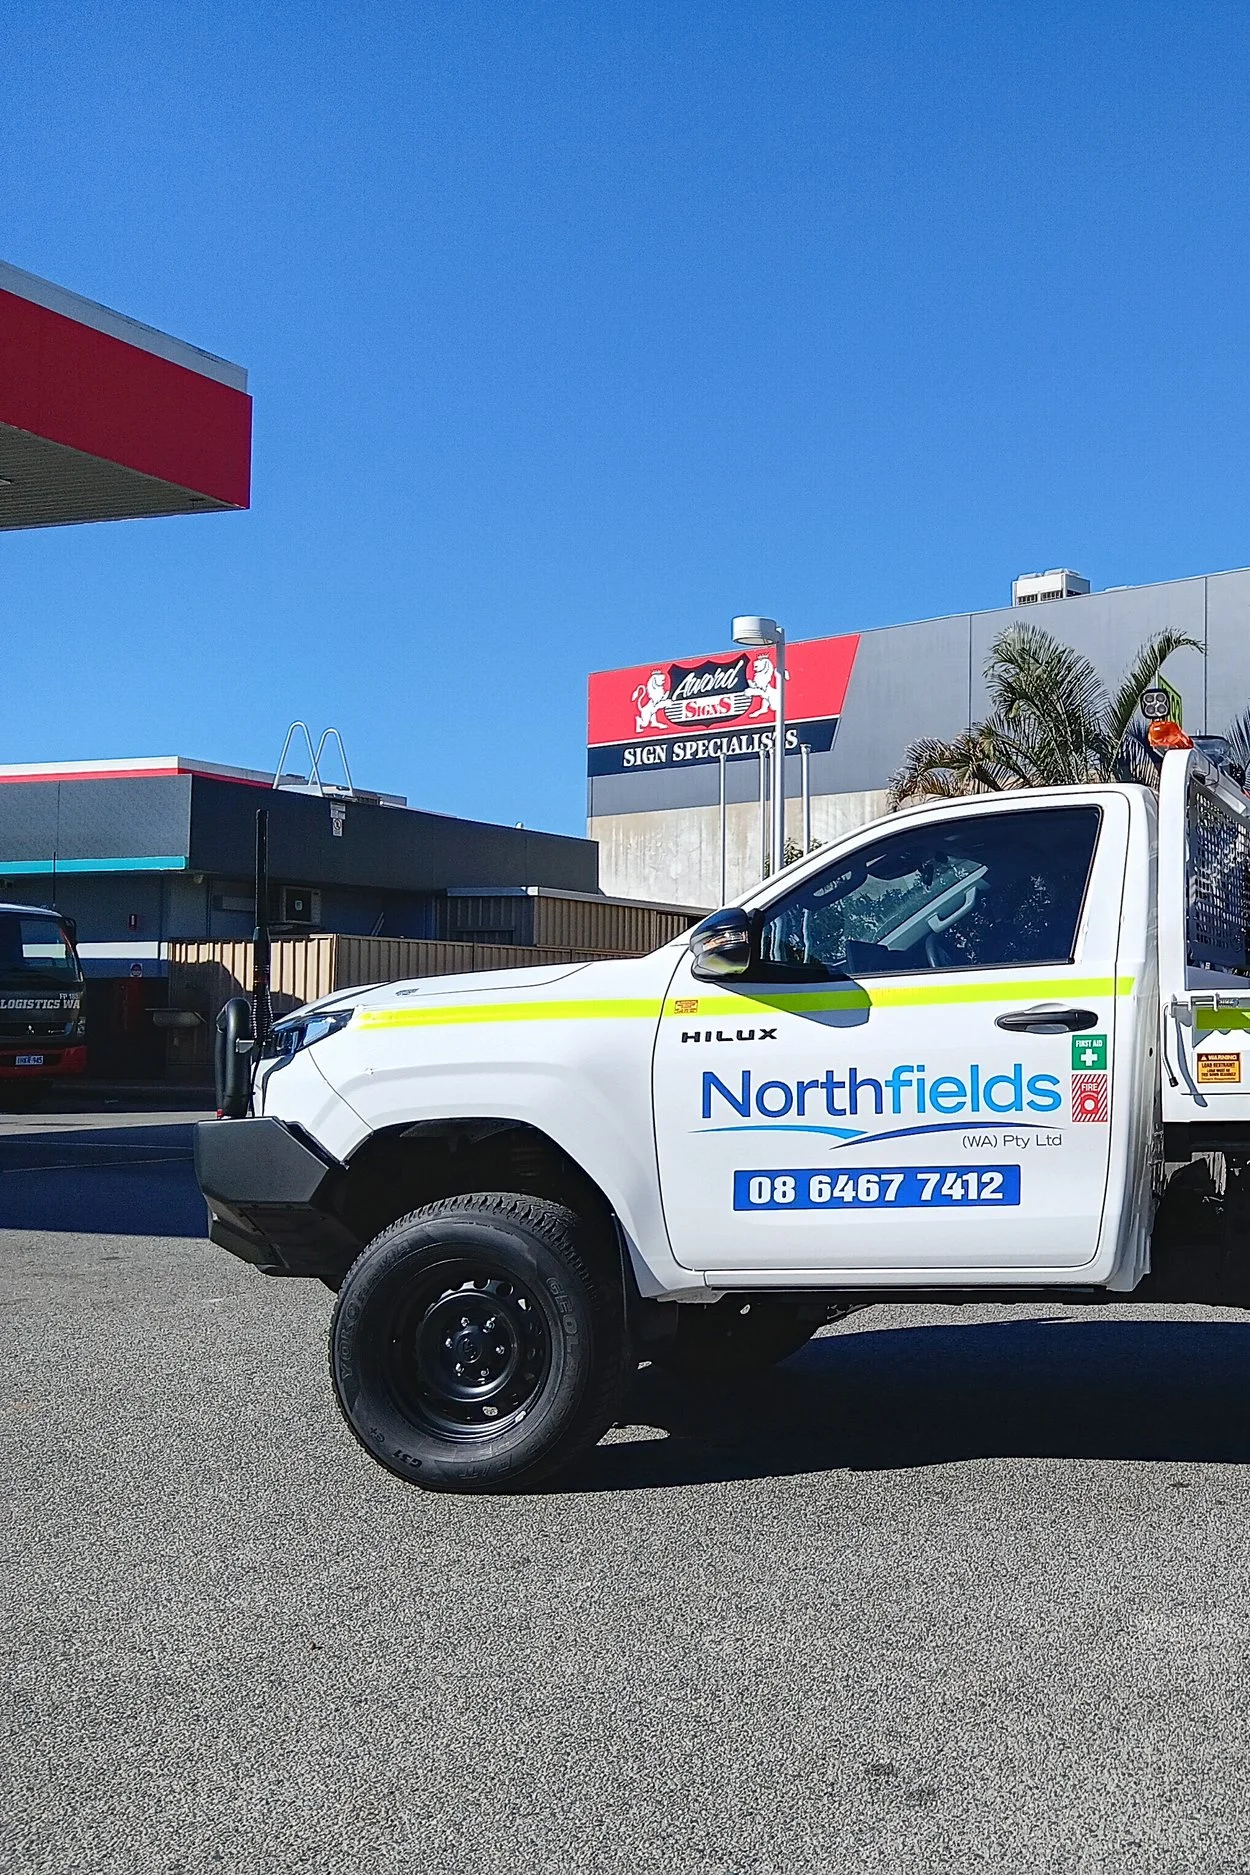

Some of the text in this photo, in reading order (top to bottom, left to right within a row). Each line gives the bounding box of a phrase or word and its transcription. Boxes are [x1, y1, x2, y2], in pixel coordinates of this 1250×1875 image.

[672, 660, 744, 701] Award
[685, 697, 732, 718] SIGNS
[623, 744, 667, 767] SIGN
[0, 999, 81, 1009] LOGISTICS WA
[681, 1028, 778, 1043] HILUX
[701, 1063, 1062, 1118] Northfields
[1081, 1083, 1098, 1092] FIRE
[963, 1133, 1062, 1149] (WA) Pty Ltd
[748, 1170, 1004, 1204] 08 6467 7412
